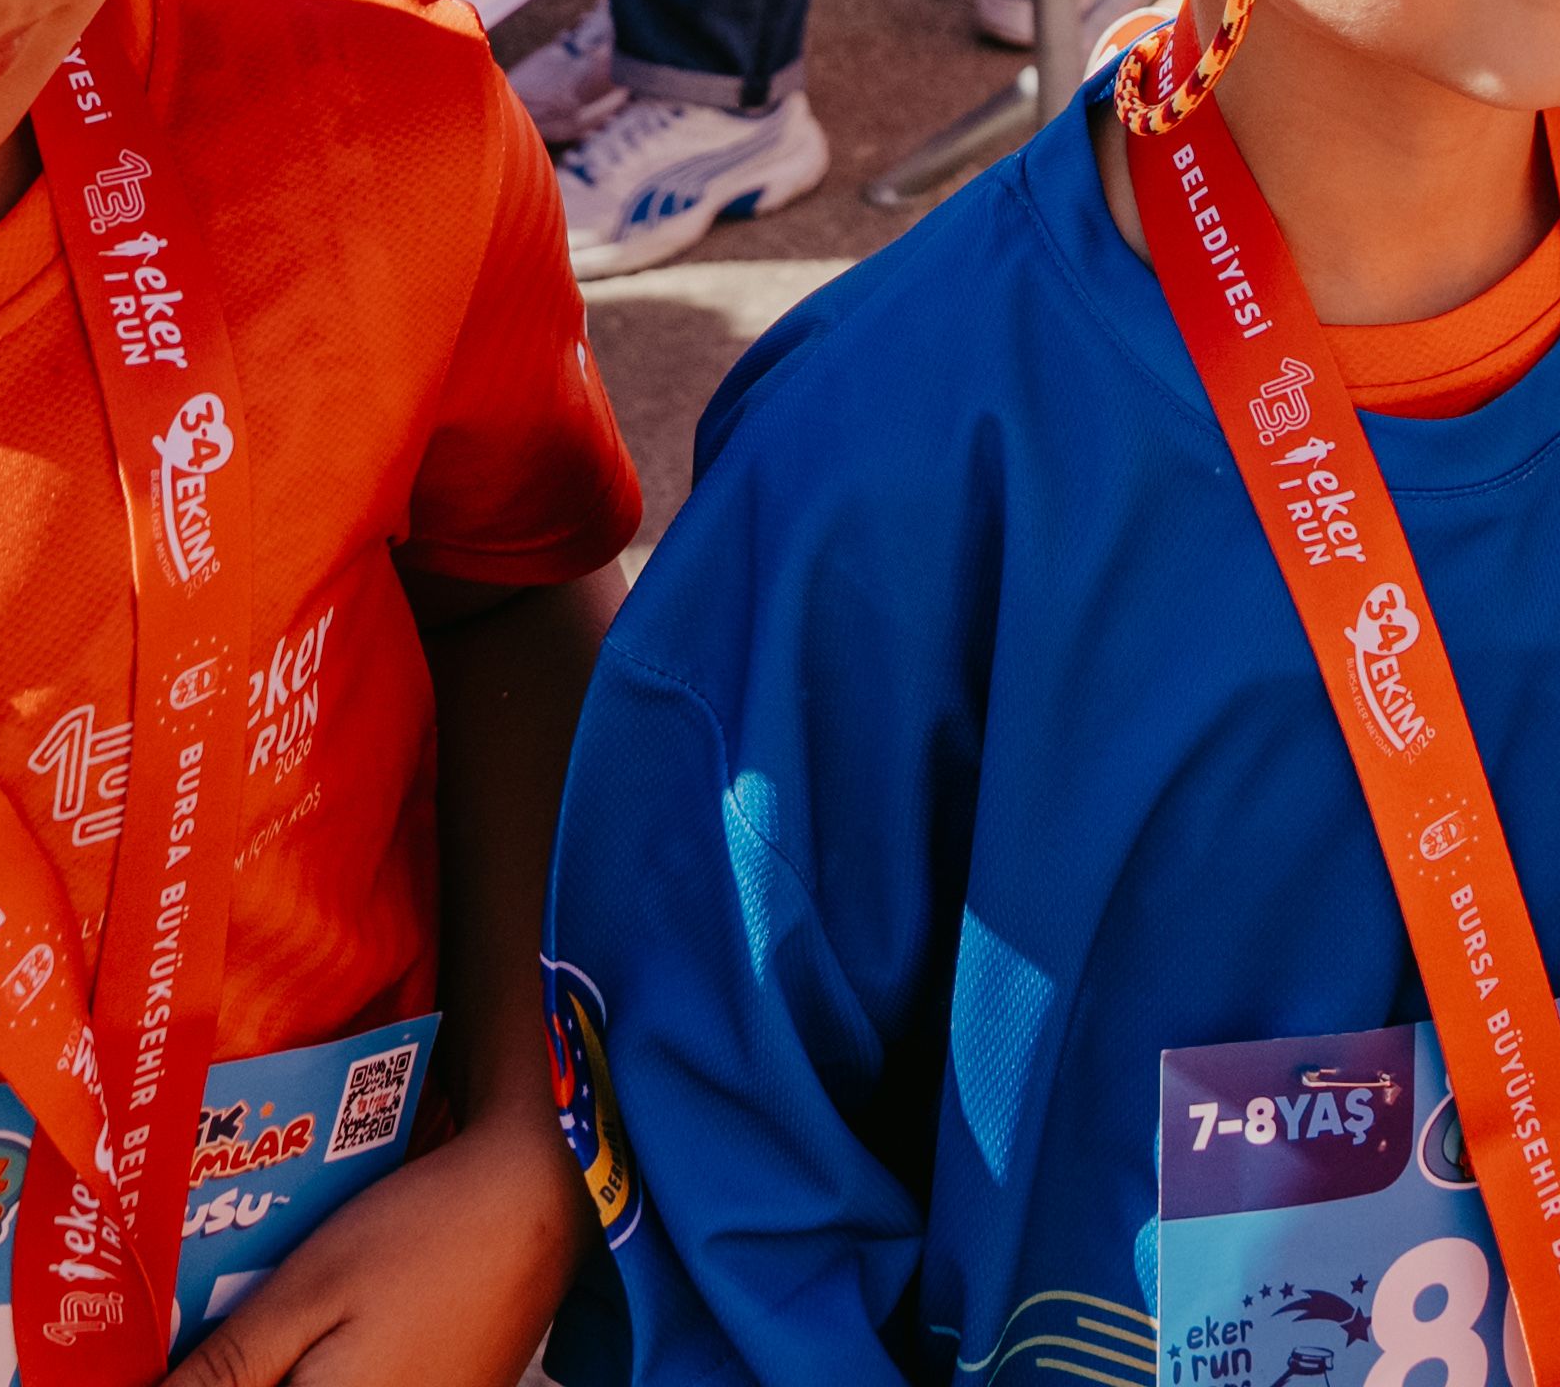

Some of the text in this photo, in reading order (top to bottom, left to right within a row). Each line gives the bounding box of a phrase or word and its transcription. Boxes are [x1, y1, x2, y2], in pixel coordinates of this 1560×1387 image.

[1171, 142, 1274, 340] BELEDİYESİ
[108, 294, 151, 366] RUN
[133, 265, 189, 370] eker
[175, 474, 216, 579] EKİM
[1286, 501, 1333, 568] RUN
[1306, 467, 1367, 565] eker
[184, 557, 223, 600] 2026
[247, 679, 320, 777] RUN
[1369, 655, 1427, 746] EKİM
[274, 734, 313, 786] 2026
[1402, 725, 1437, 766] 2026
[165, 739, 204, 871] BURSA
[248, 781, 324, 859] İÇİN KOŞ
[1450, 883, 1500, 1002] BURSA
[128, 879, 189, 1111] BÜYÜKŞEHİR
[189, 1113, 316, 1189] MLAR
[53, 1181, 101, 1256] eke
[1185, 1314, 1254, 1350] eker
[1192, 1345, 1253, 1382] run
